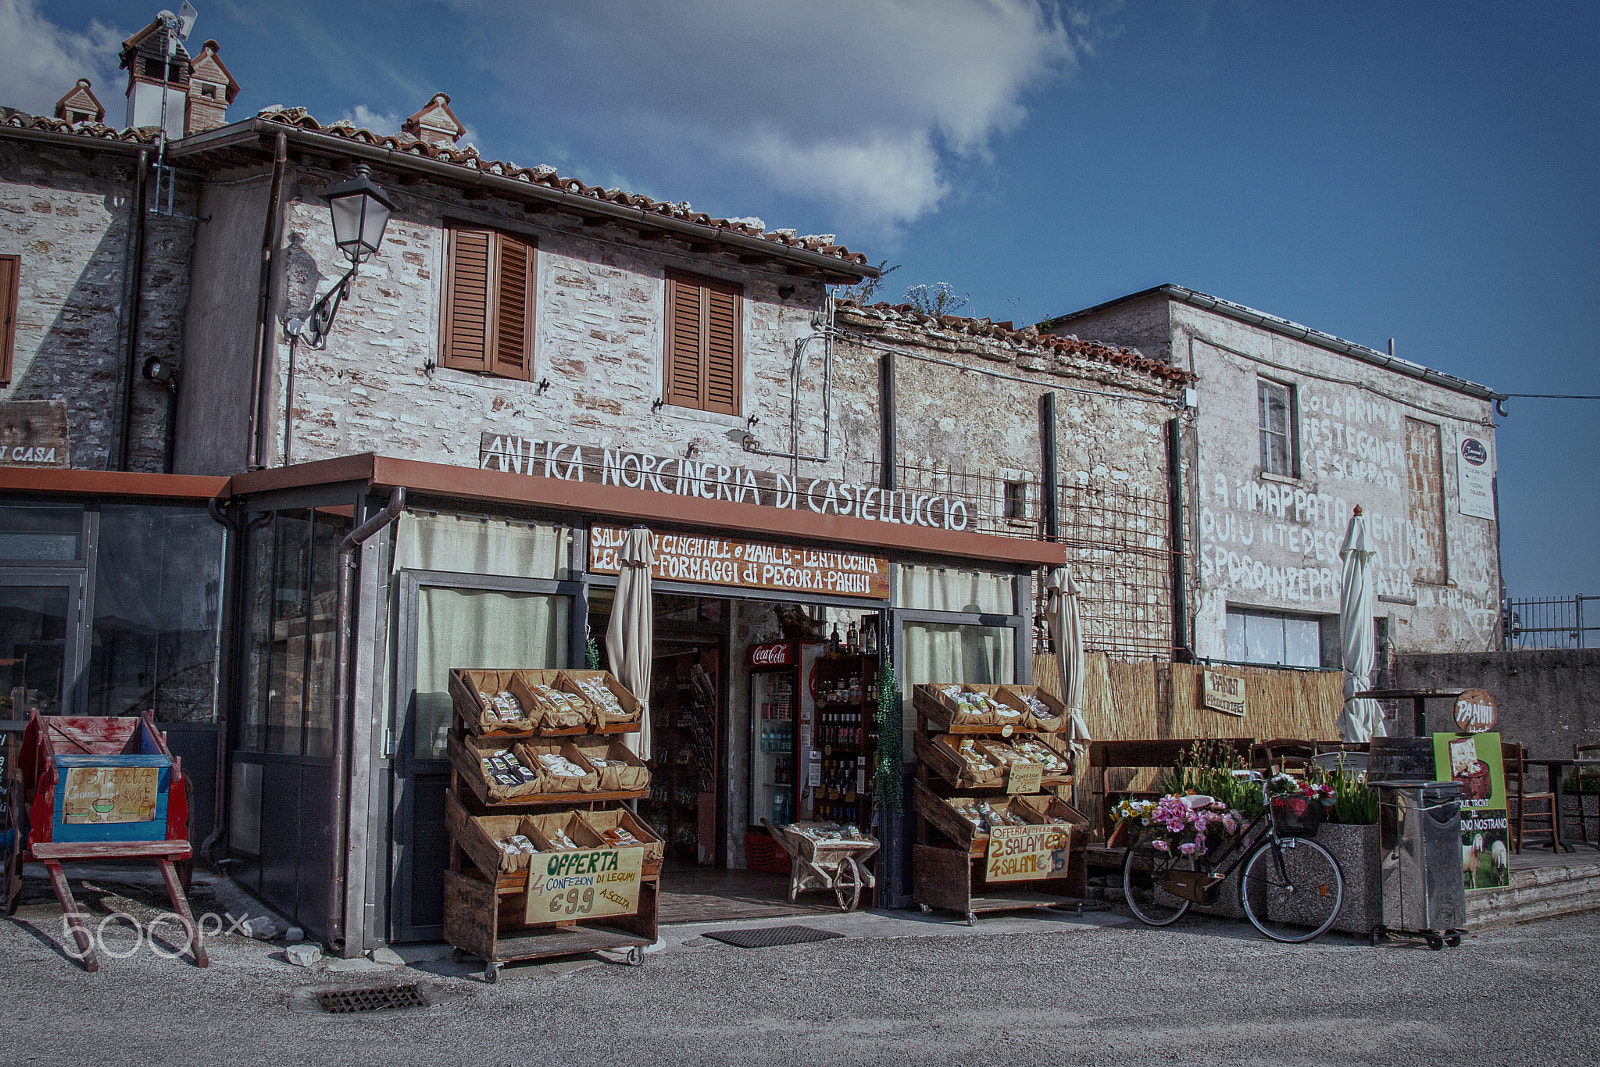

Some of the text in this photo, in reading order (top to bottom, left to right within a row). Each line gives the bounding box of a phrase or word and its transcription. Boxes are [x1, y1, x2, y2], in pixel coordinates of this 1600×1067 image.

[12, 446, 56, 462] CASA
[481, 436, 968, 531] ANTICA NORCINERIA DI CASTELLUCCIO
[662, 535, 732, 559] CINGHIALE
[744, 542, 792, 565] MAIALE
[803, 548, 879, 574] LENTICCHIA
[743, 562, 757, 583] di
[992, 826, 1028, 839] OFFERTA
[1474, 818, 1508, 830] NOSTRANO
[990, 839, 1004, 858] 2
[1005, 834, 1044, 856] SALAMI
[547, 851, 619, 876] OFFERTA
[989, 858, 1001, 877] 4
[1001, 854, 1037, 876] SALAMI
[531, 873, 544, 896] 4
[596, 874, 604, 884] DI
[607, 872, 636, 883] LEGUMI
[606, 890, 631, 910] SCELTA
